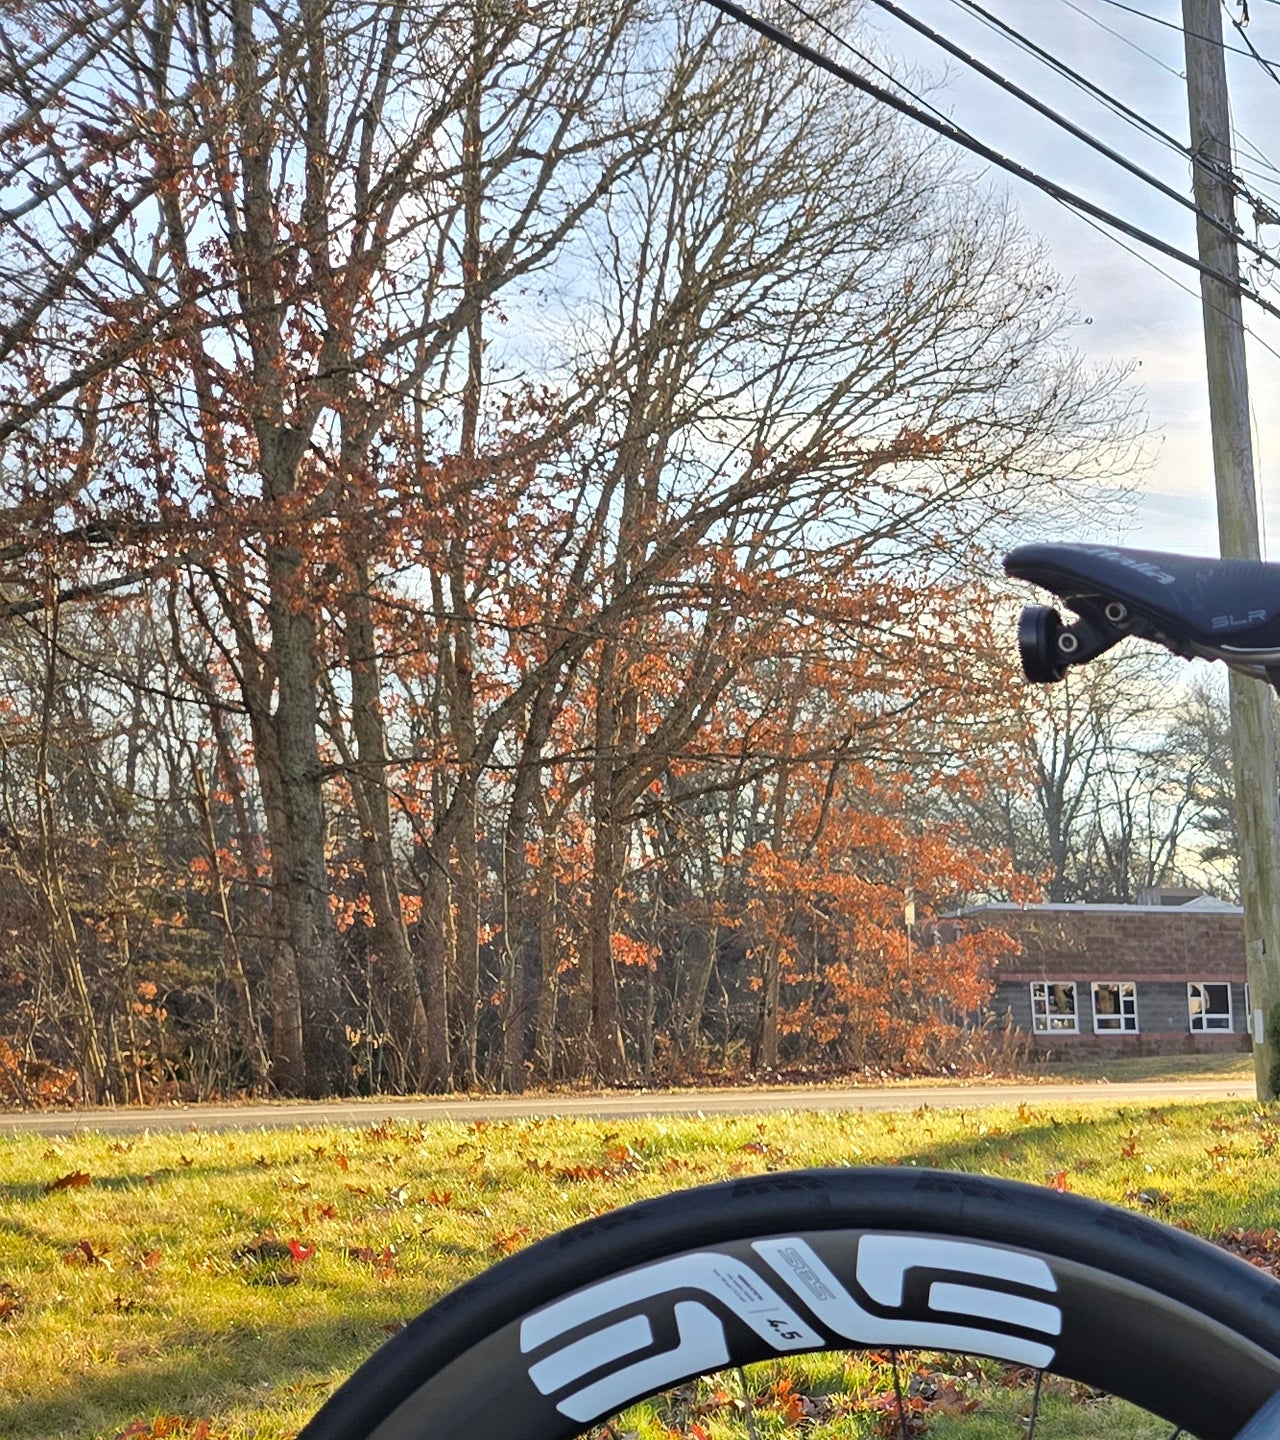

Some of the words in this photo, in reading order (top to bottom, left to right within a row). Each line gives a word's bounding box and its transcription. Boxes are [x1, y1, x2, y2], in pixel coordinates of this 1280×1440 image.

[1211, 609, 1267, 629] SLR
[777, 1247, 836, 1301] SES
[766, 1319, 803, 1340] 4.5
